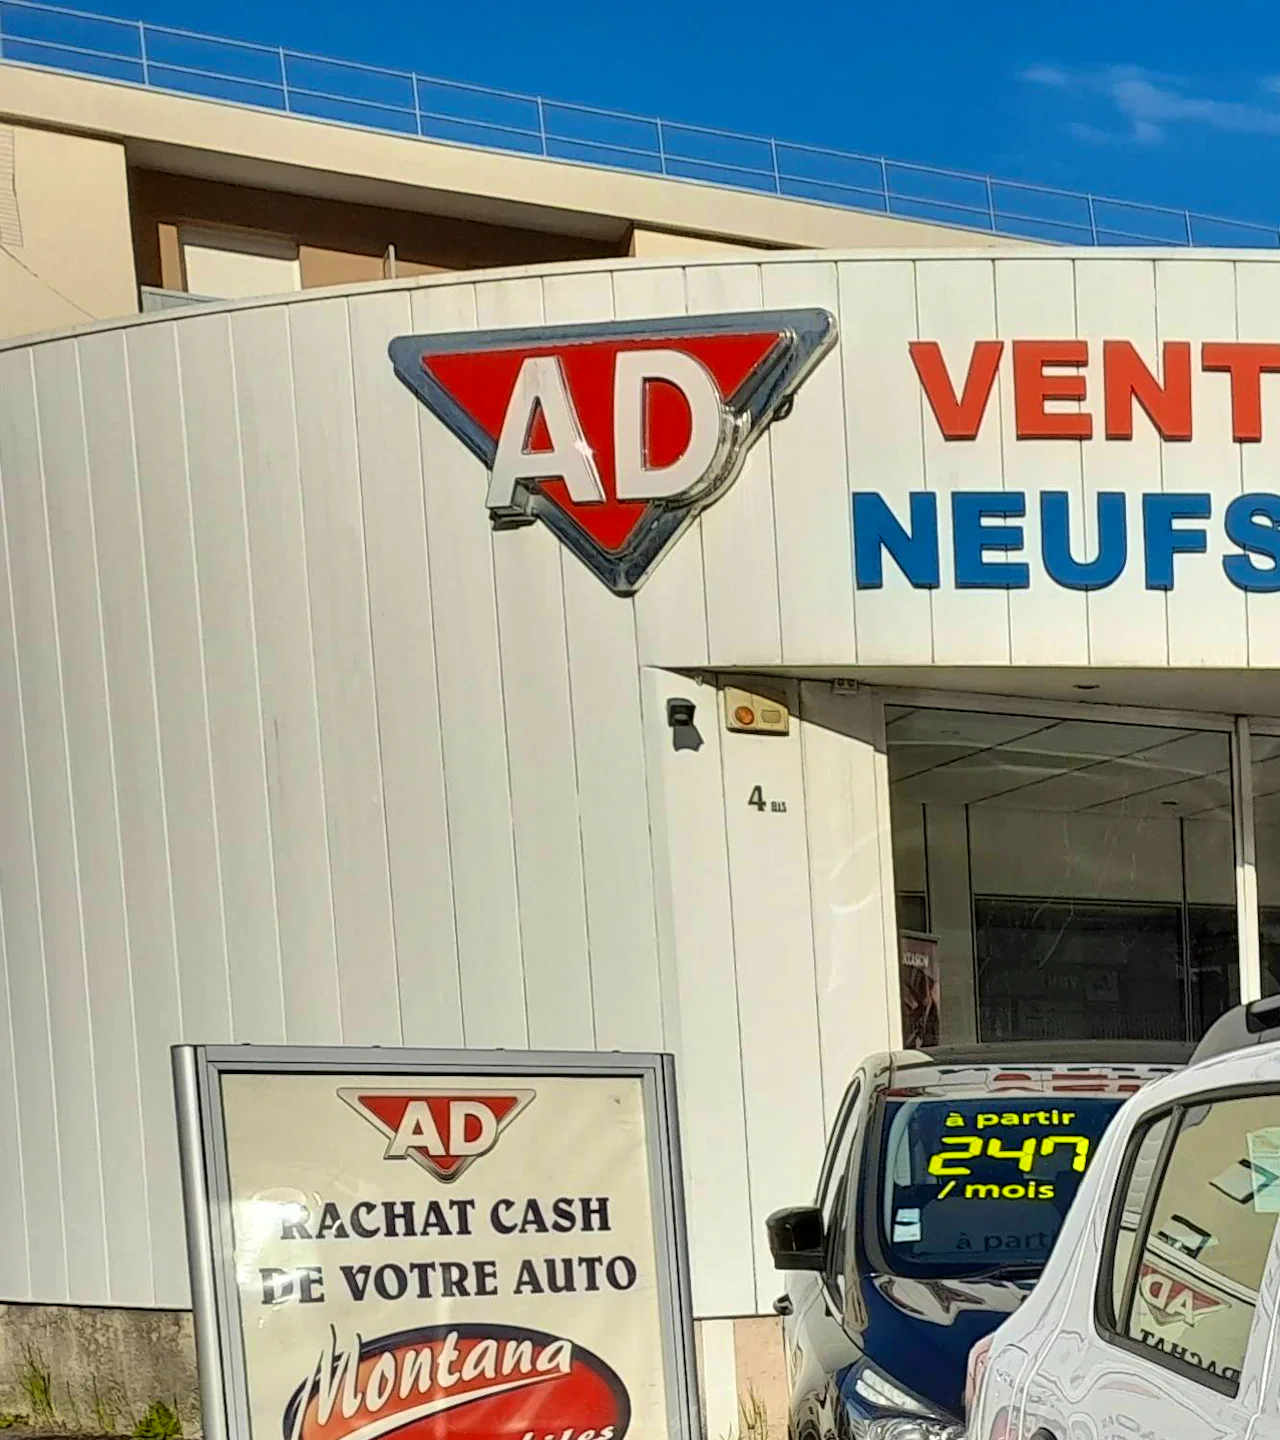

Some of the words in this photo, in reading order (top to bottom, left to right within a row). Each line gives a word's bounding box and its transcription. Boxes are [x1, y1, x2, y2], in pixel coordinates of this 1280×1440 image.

[487, 347, 733, 510] AD
[748, 785, 767, 812] 4
[384, 1100, 498, 1160] AD
[945, 1110, 965, 1128] à
[976, 1109, 1077, 1130] partir
[927, 1135, 1090, 1176] 247
[964, 1180, 1056, 1199] mois
[280, 1199, 475, 1240] RACHAT
[490, 1197, 612, 1234] CASH
[259, 1266, 325, 1305] DE
[340, 1259, 498, 1301] VOTRE
[513, 1255, 637, 1294] AUTO
